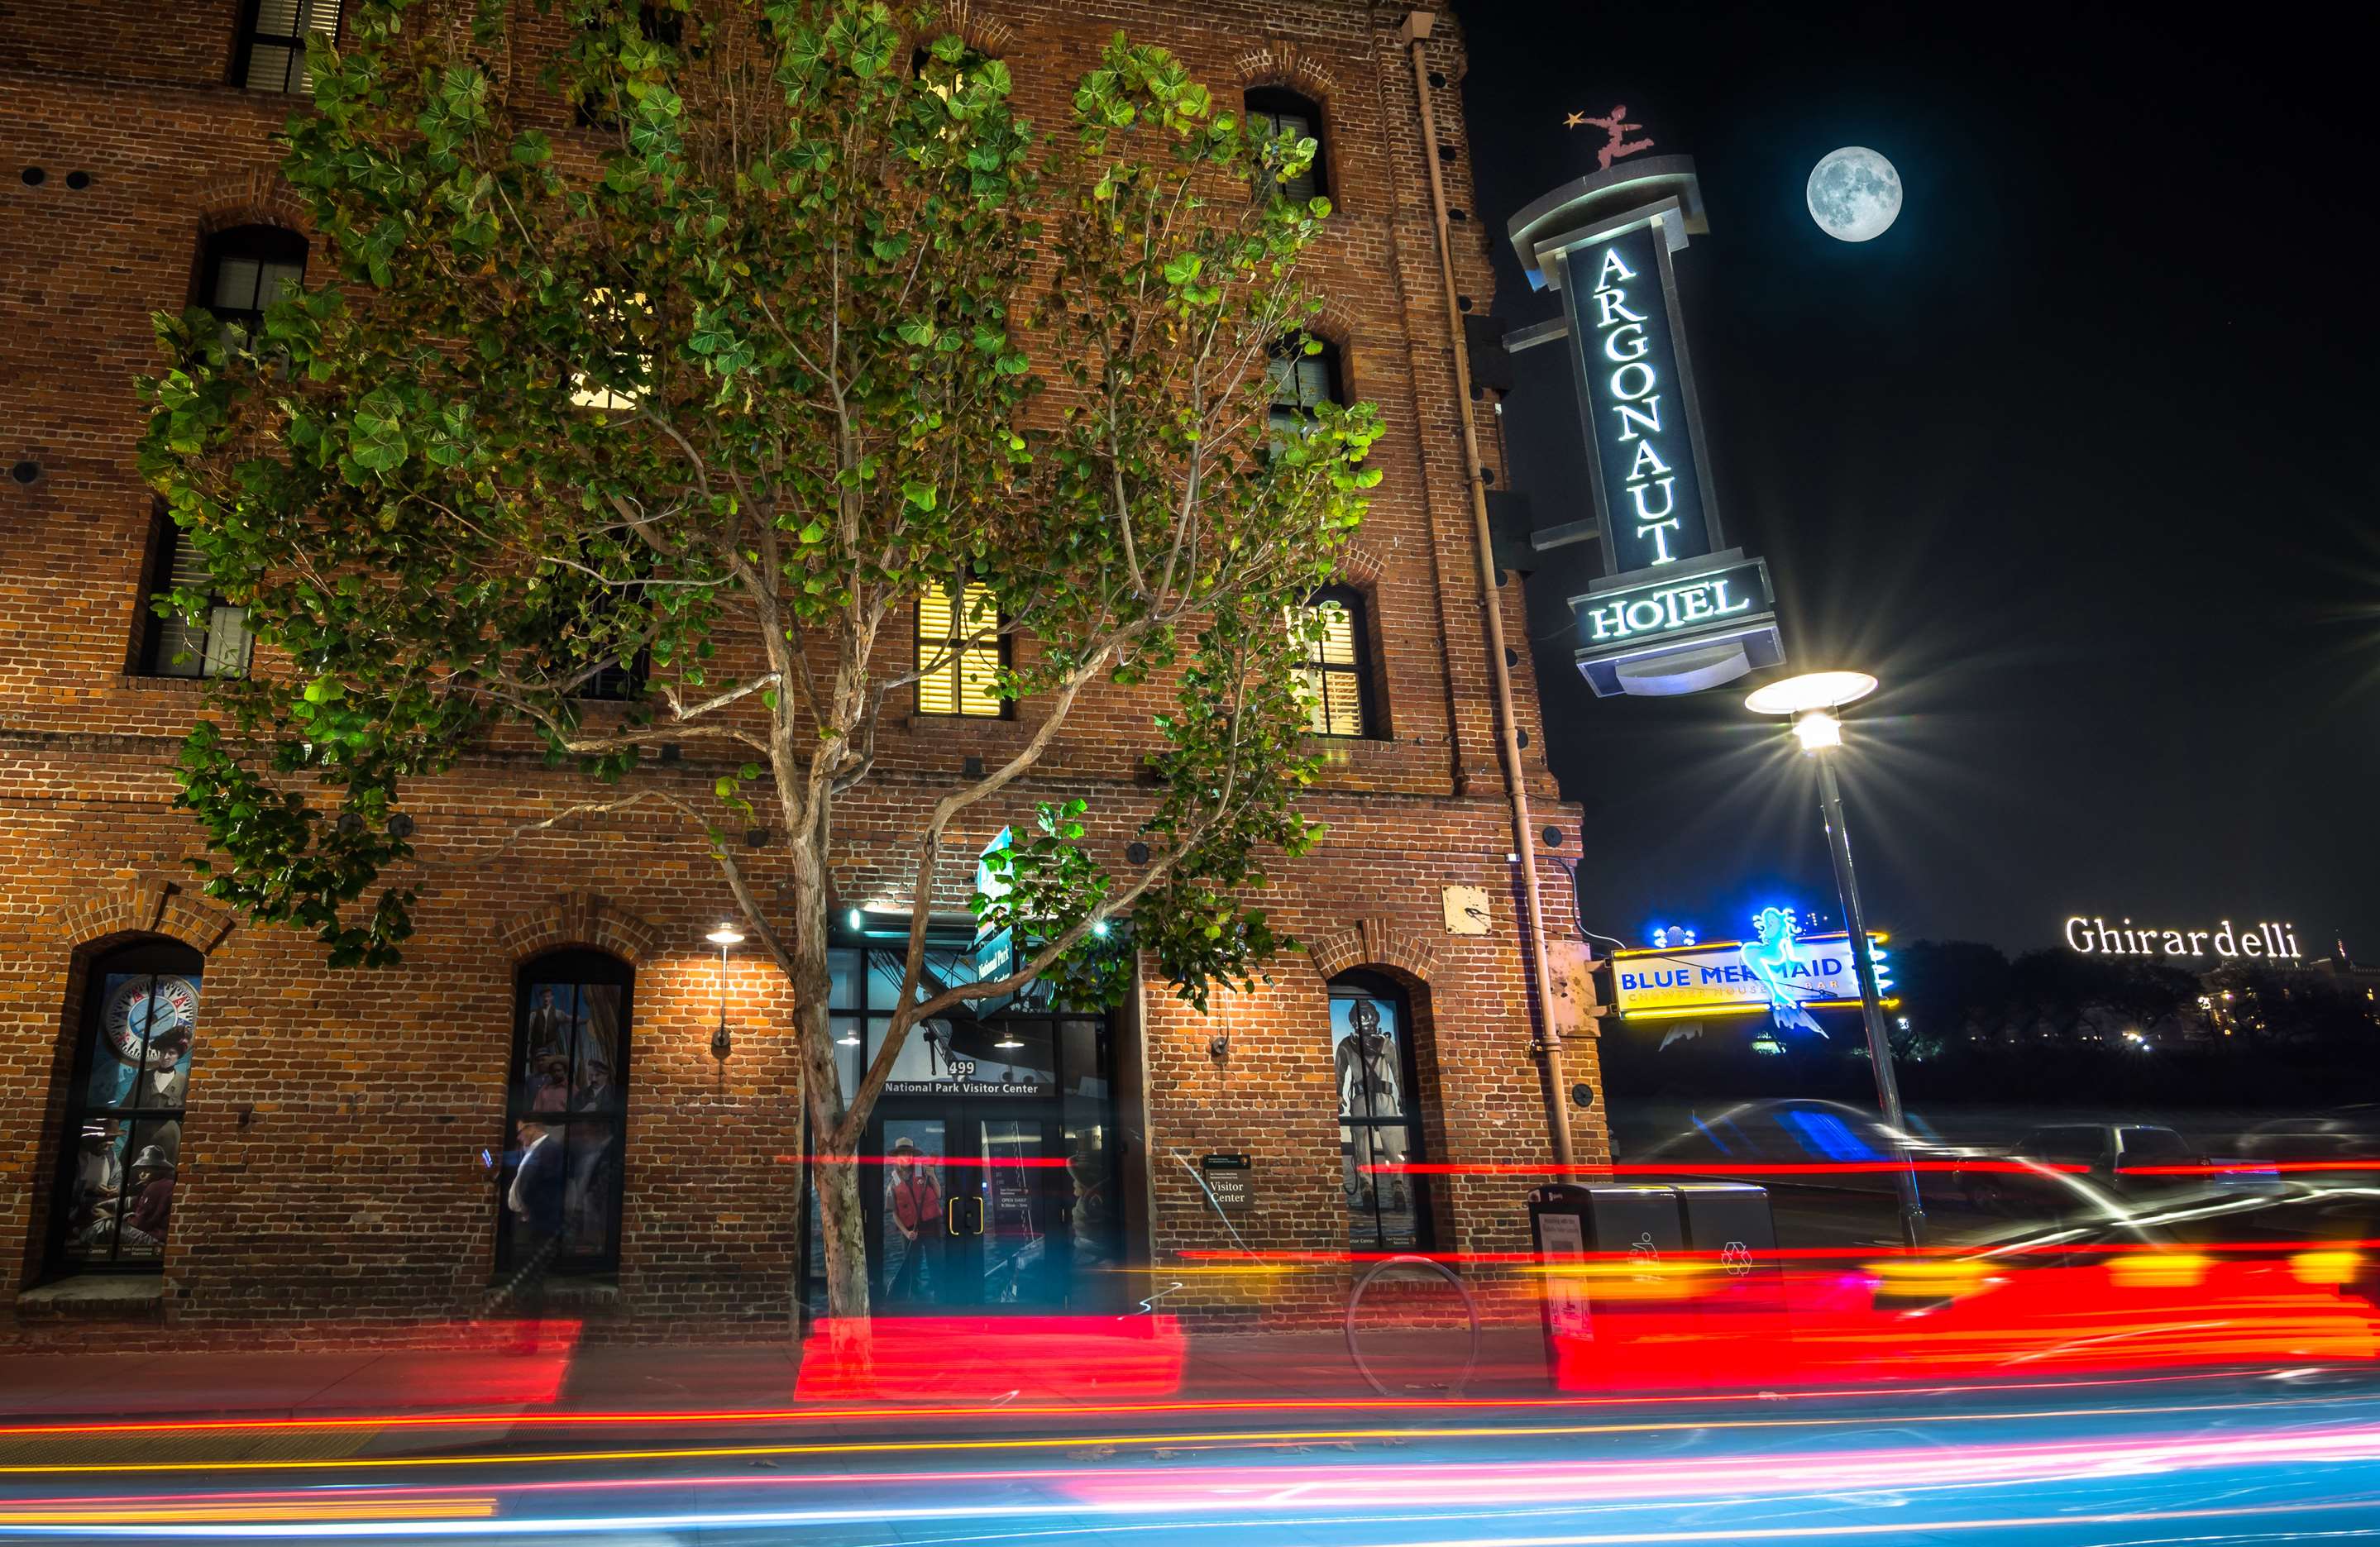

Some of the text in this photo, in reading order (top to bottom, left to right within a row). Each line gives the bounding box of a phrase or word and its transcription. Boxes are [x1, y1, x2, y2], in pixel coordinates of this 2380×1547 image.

[1594, 247, 1680, 567] ARGONAUT
[1588, 580, 1750, 639] HOTEL
[2066, 916, 2302, 958] Ghirardelli
[978, 944, 1010, 981] National Park
[1621, 958, 1843, 991] BLUE MERAID
[1713, 985, 1767, 996] HOUSE
[1804, 981, 1840, 991] BAR
[949, 1062, 975, 1074] 499
[885, 1082, 1039, 1093] National Park Visitor Center
[1210, 1181, 1244, 1191] Visitor
[1211, 1192, 1245, 1202] Center
